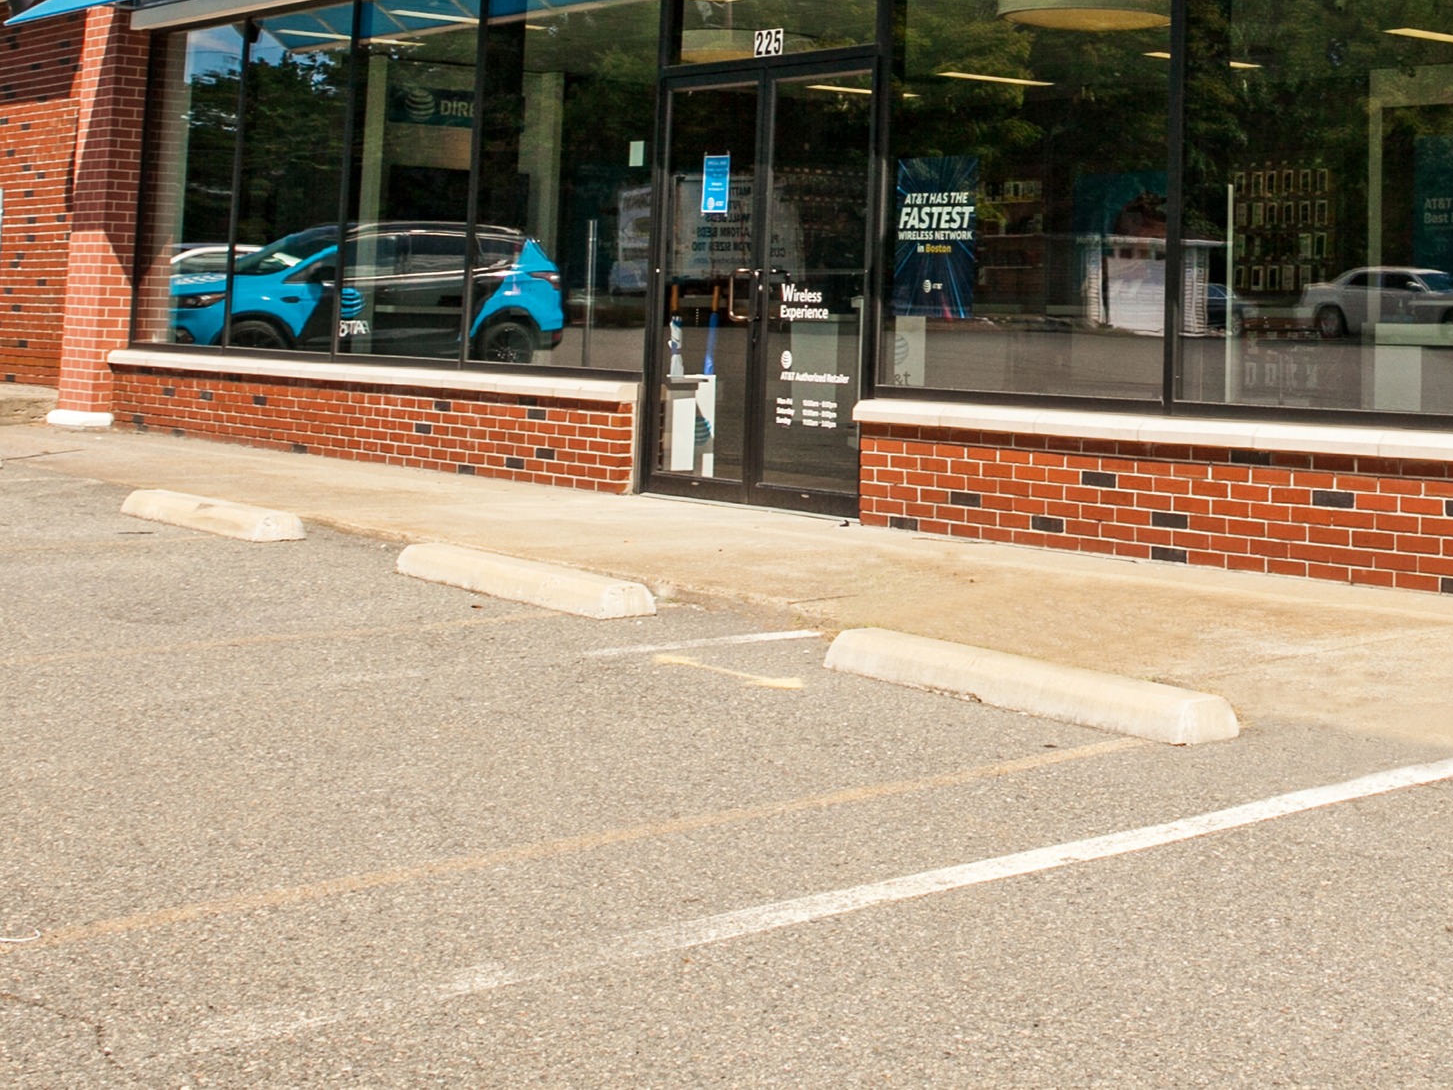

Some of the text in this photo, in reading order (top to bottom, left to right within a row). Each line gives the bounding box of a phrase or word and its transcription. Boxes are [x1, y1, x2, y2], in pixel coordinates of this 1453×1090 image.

[756, 30, 781, 56] 225
[904, 191, 969, 204] AT&T HAS THE
[1424, 198, 1453, 209] AT&T
[899, 206, 975, 229] FASTEST
[1423, 211, 1448, 224] Best
[898, 230, 973, 240] WIRELESS NETWORK
[917, 242, 952, 253] in Boston
[781, 283, 823, 303] Wireless
[780, 305, 829, 322] Experience
[780, 371, 850, 384] AT&T Authorized Retailer
